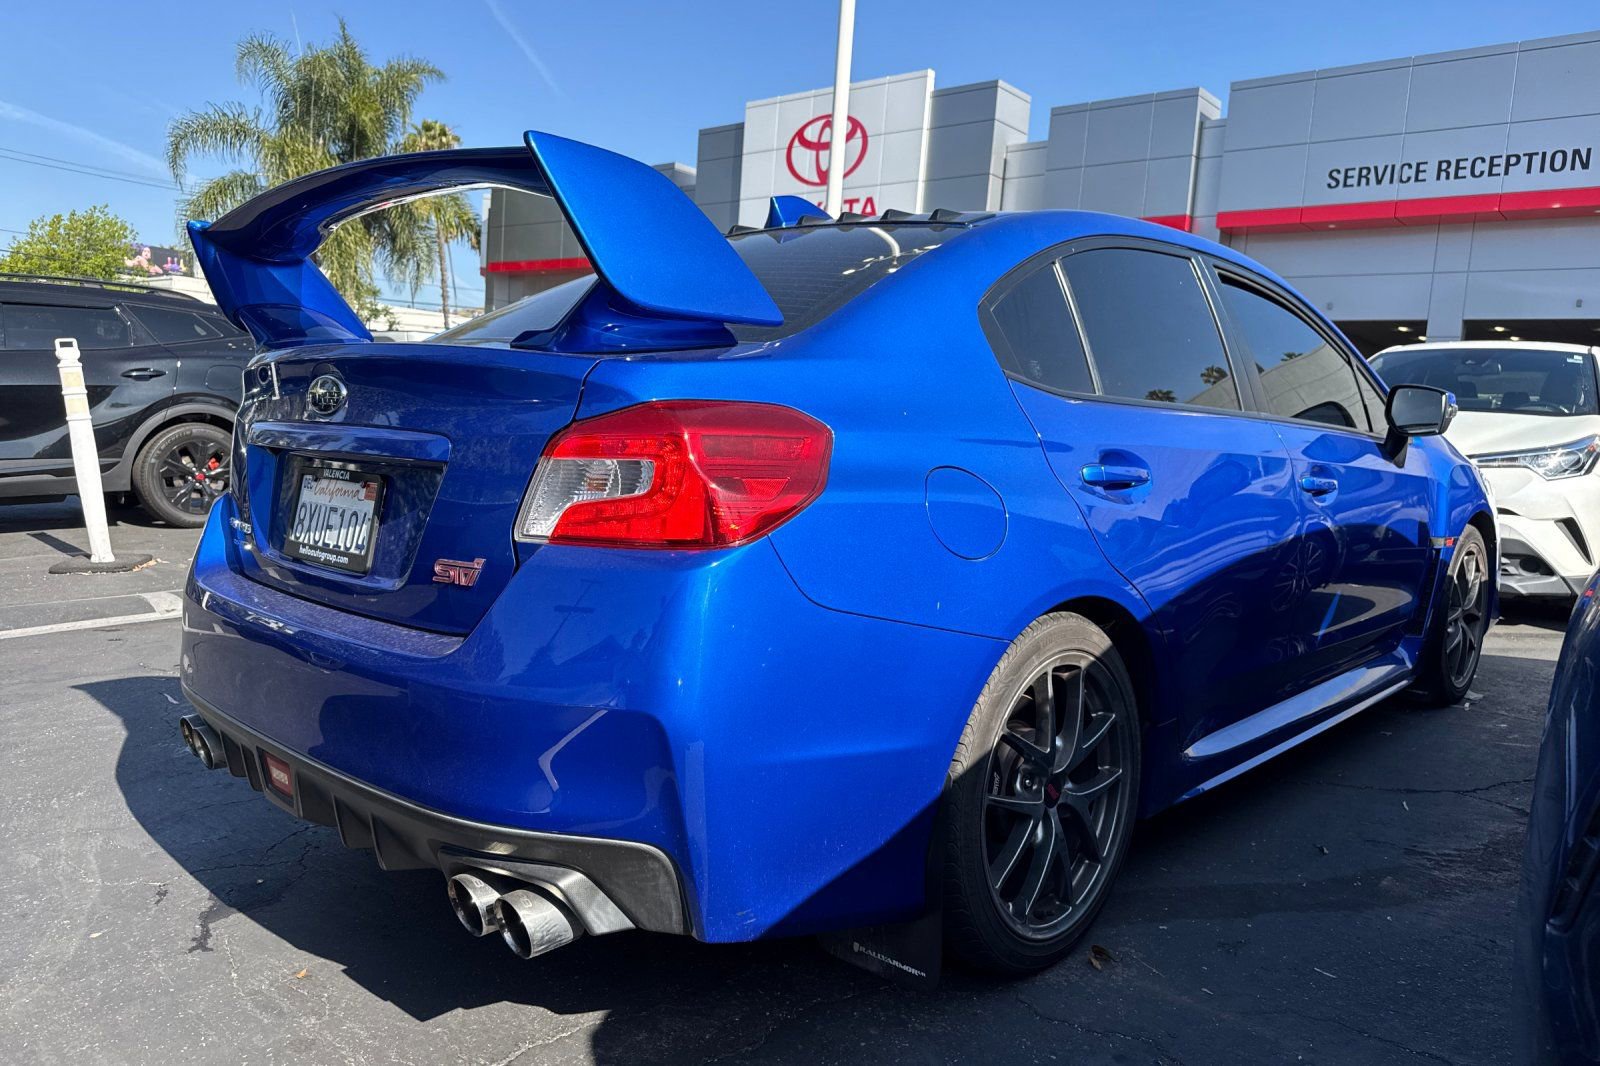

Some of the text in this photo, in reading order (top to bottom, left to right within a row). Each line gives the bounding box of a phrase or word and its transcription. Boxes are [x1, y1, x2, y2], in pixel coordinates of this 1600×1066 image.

[1326, 147, 1593, 189] SERVICE RECEPTION
[323, 468, 350, 481] VALENCIA
[314, 479, 364, 503] California
[293, 502, 368, 553] 8XUE104
[432, 558, 487, 587] STI
